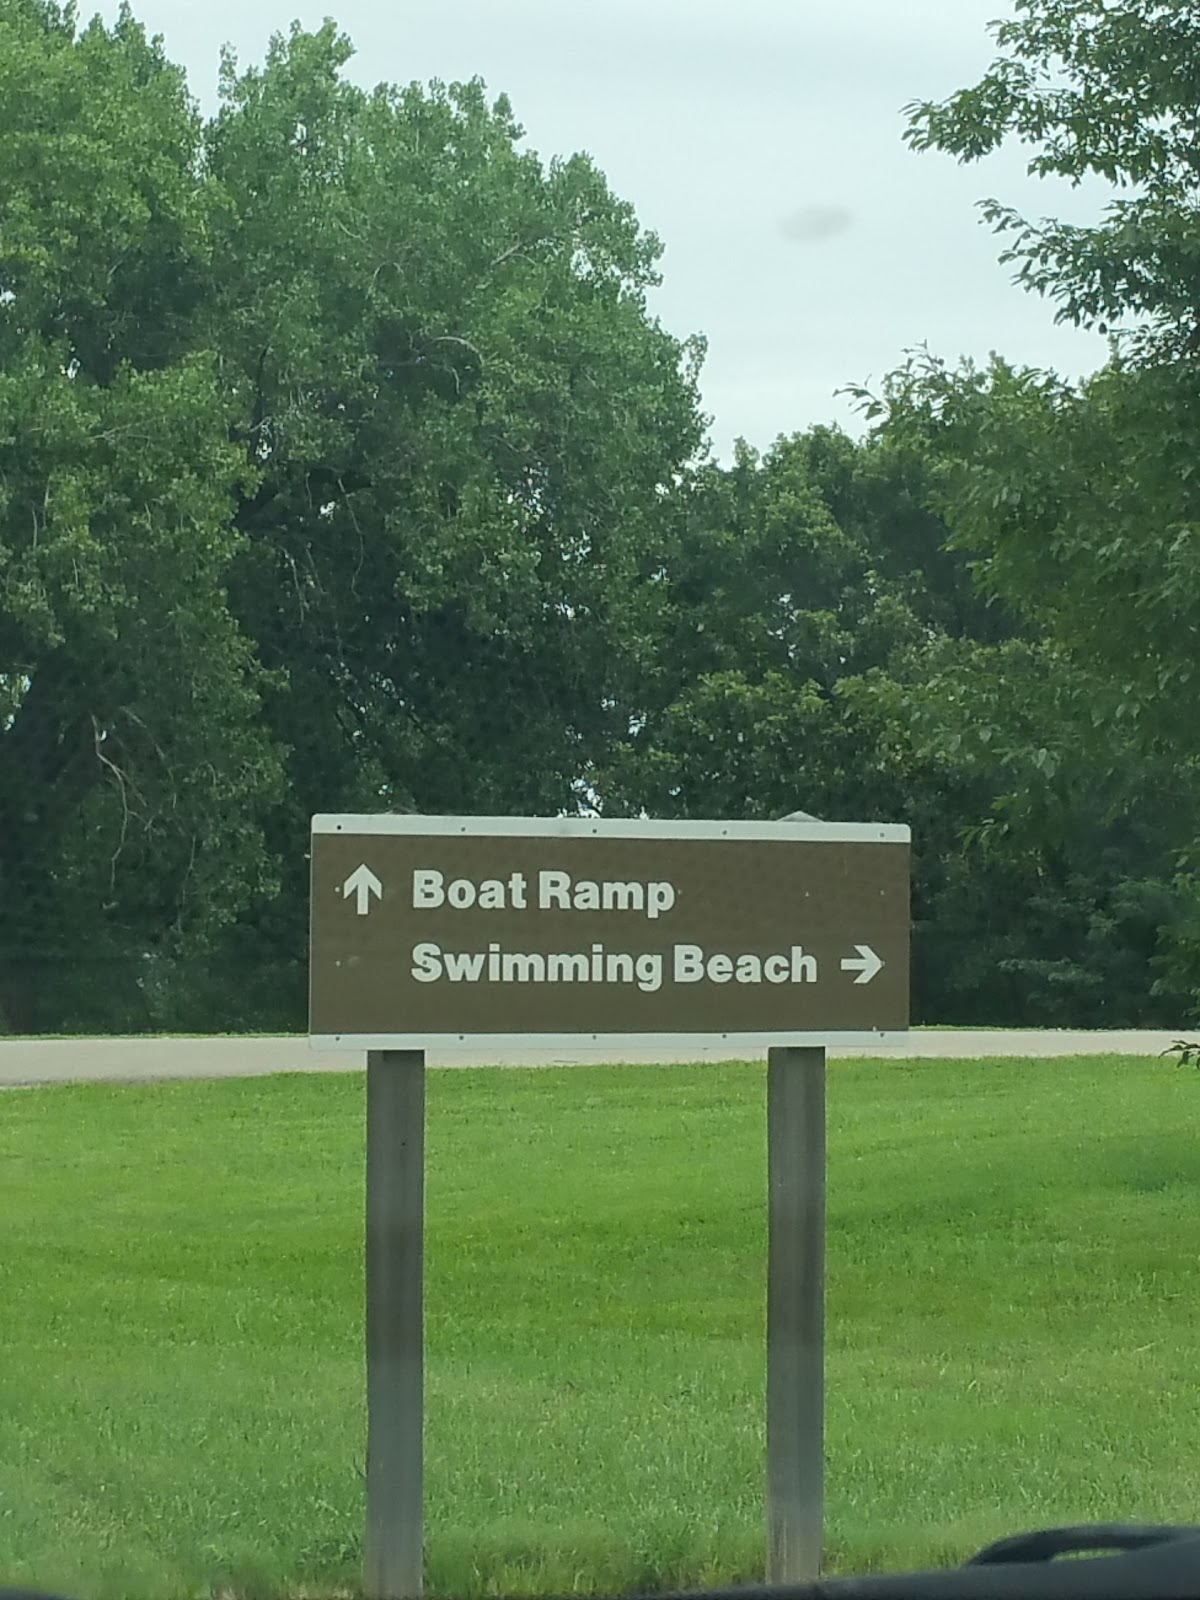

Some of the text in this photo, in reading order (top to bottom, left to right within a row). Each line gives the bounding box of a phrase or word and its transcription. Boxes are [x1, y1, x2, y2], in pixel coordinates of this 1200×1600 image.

[412, 869, 675, 919] Boat Ramp
[411, 943, 818, 992] Swimming Beach
